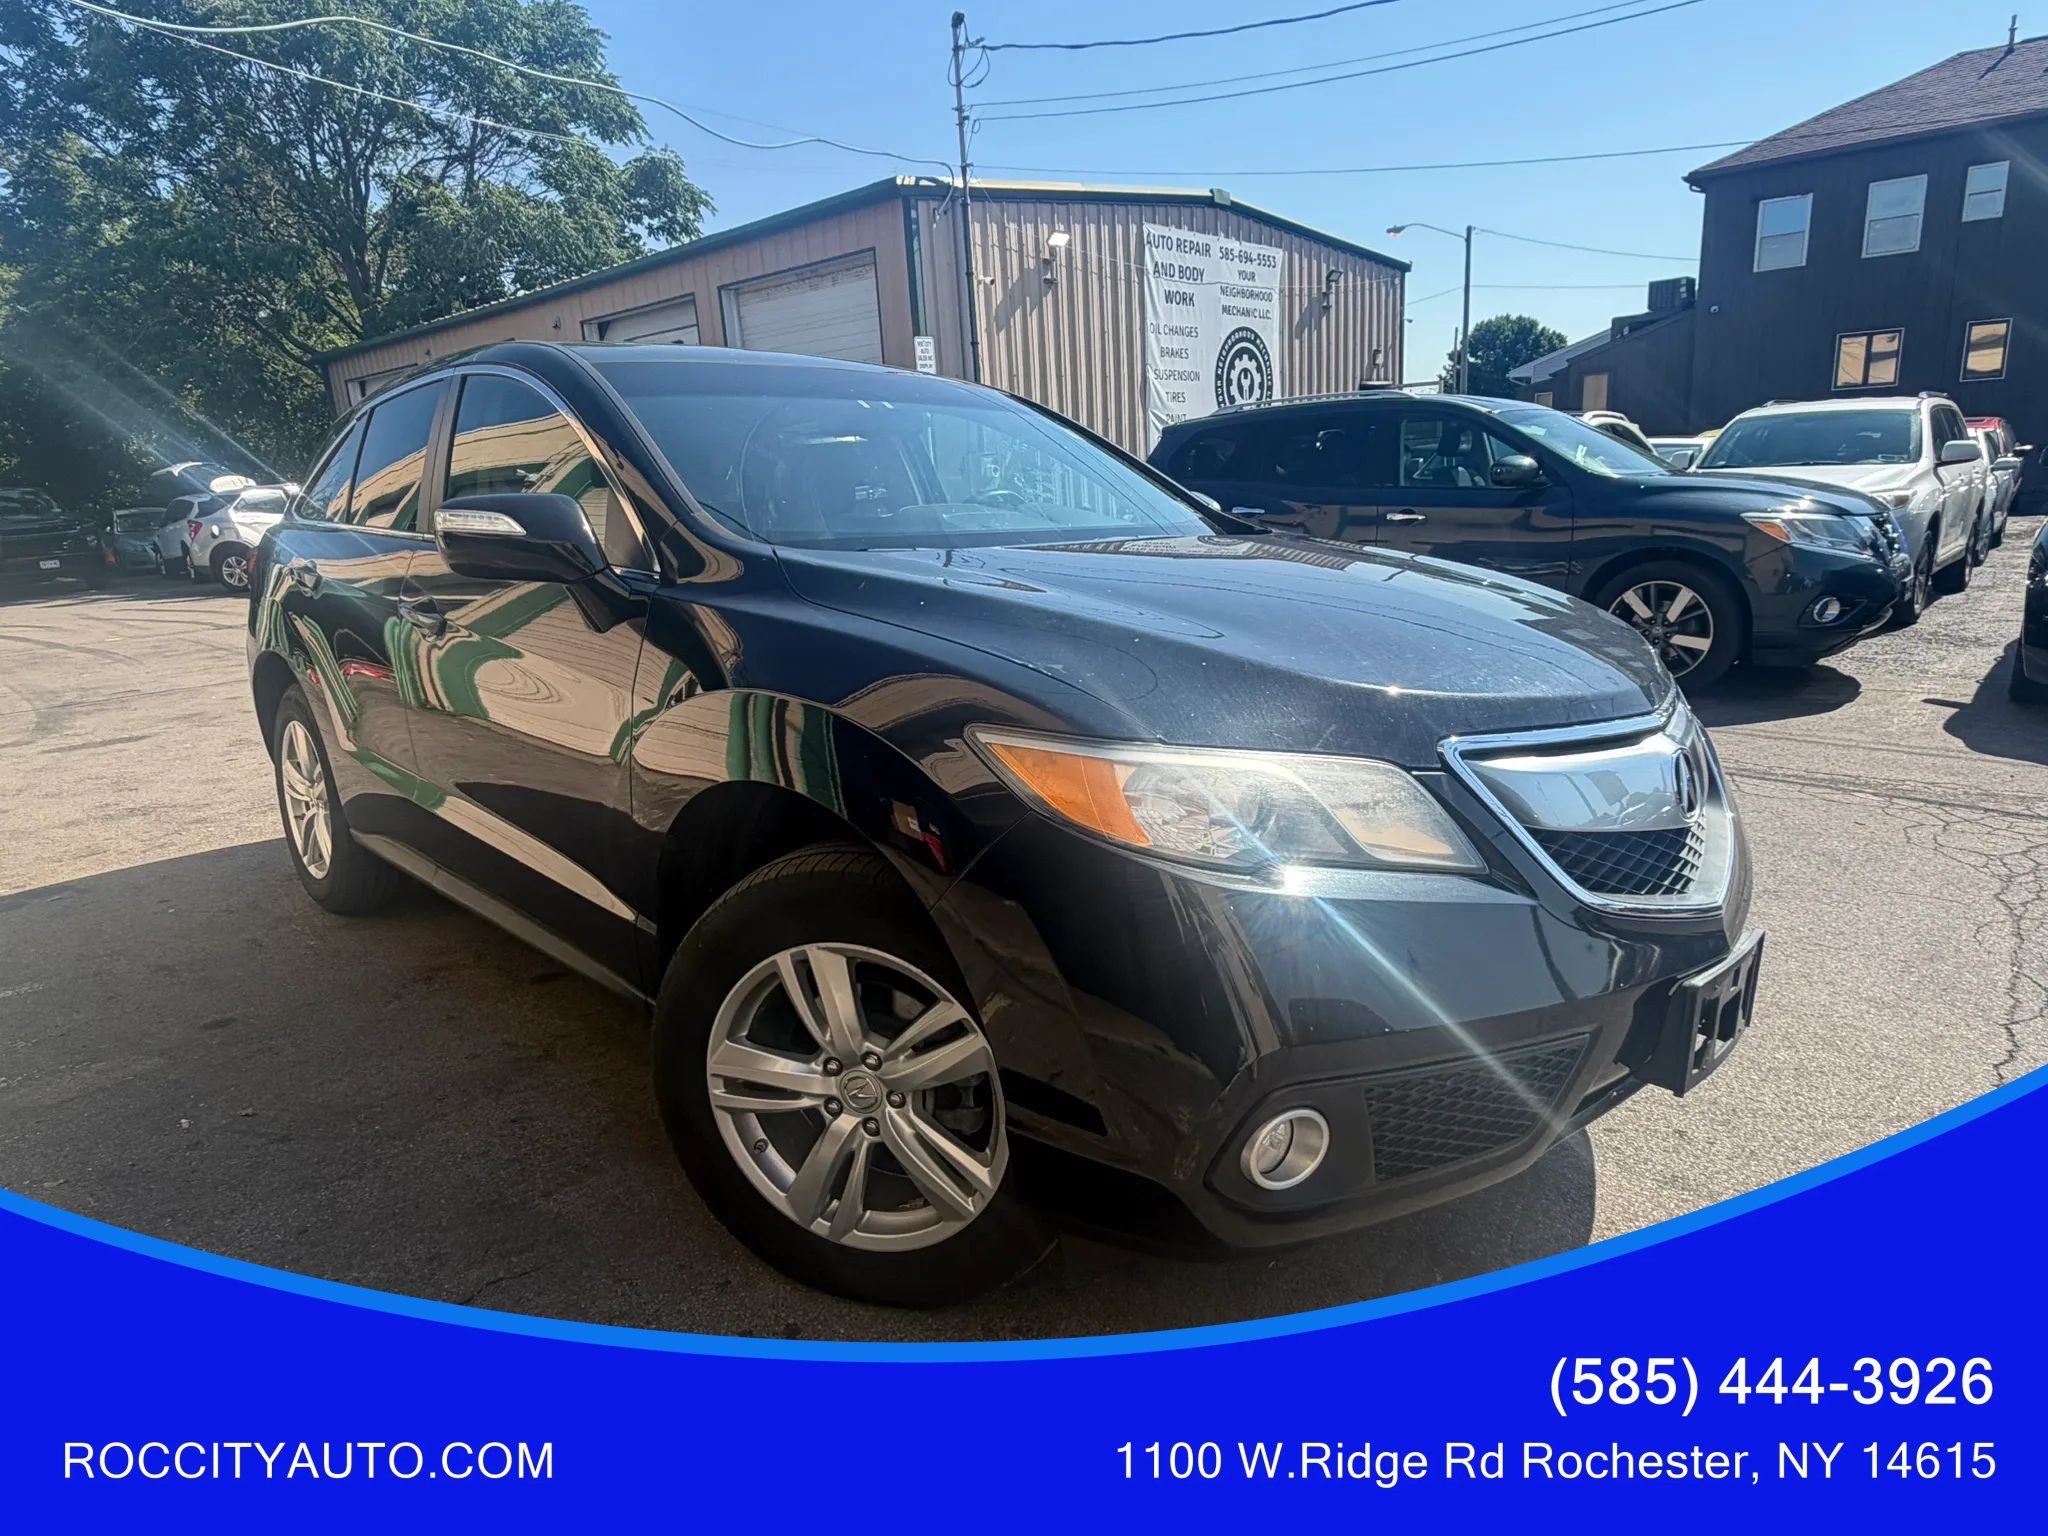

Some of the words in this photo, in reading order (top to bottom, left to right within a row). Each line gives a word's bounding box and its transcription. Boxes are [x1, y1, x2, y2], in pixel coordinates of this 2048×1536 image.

[1146, 231, 1173, 252] AUTO
[1176, 236, 1211, 258] REPAIR
[1219, 245, 1277, 269] 585-694-5553
[1153, 260, 1175, 278] AND
[1178, 264, 1205, 283] BODY
[1237, 269, 1256, 282] YOUR
[1164, 288, 1195, 308] WORK
[1220, 285, 1273, 303] NEIGHBORHOOD
[1221, 304, 1257, 319] MECHANIC
[1150, 321, 1162, 335] OIL
[1163, 323, 1199, 338] CHANGES
[1160, 346, 1190, 360] BRAKES
[1153, 368, 1201, 382] SUSPENSION
[1165, 391, 1186, 403] TIRES
